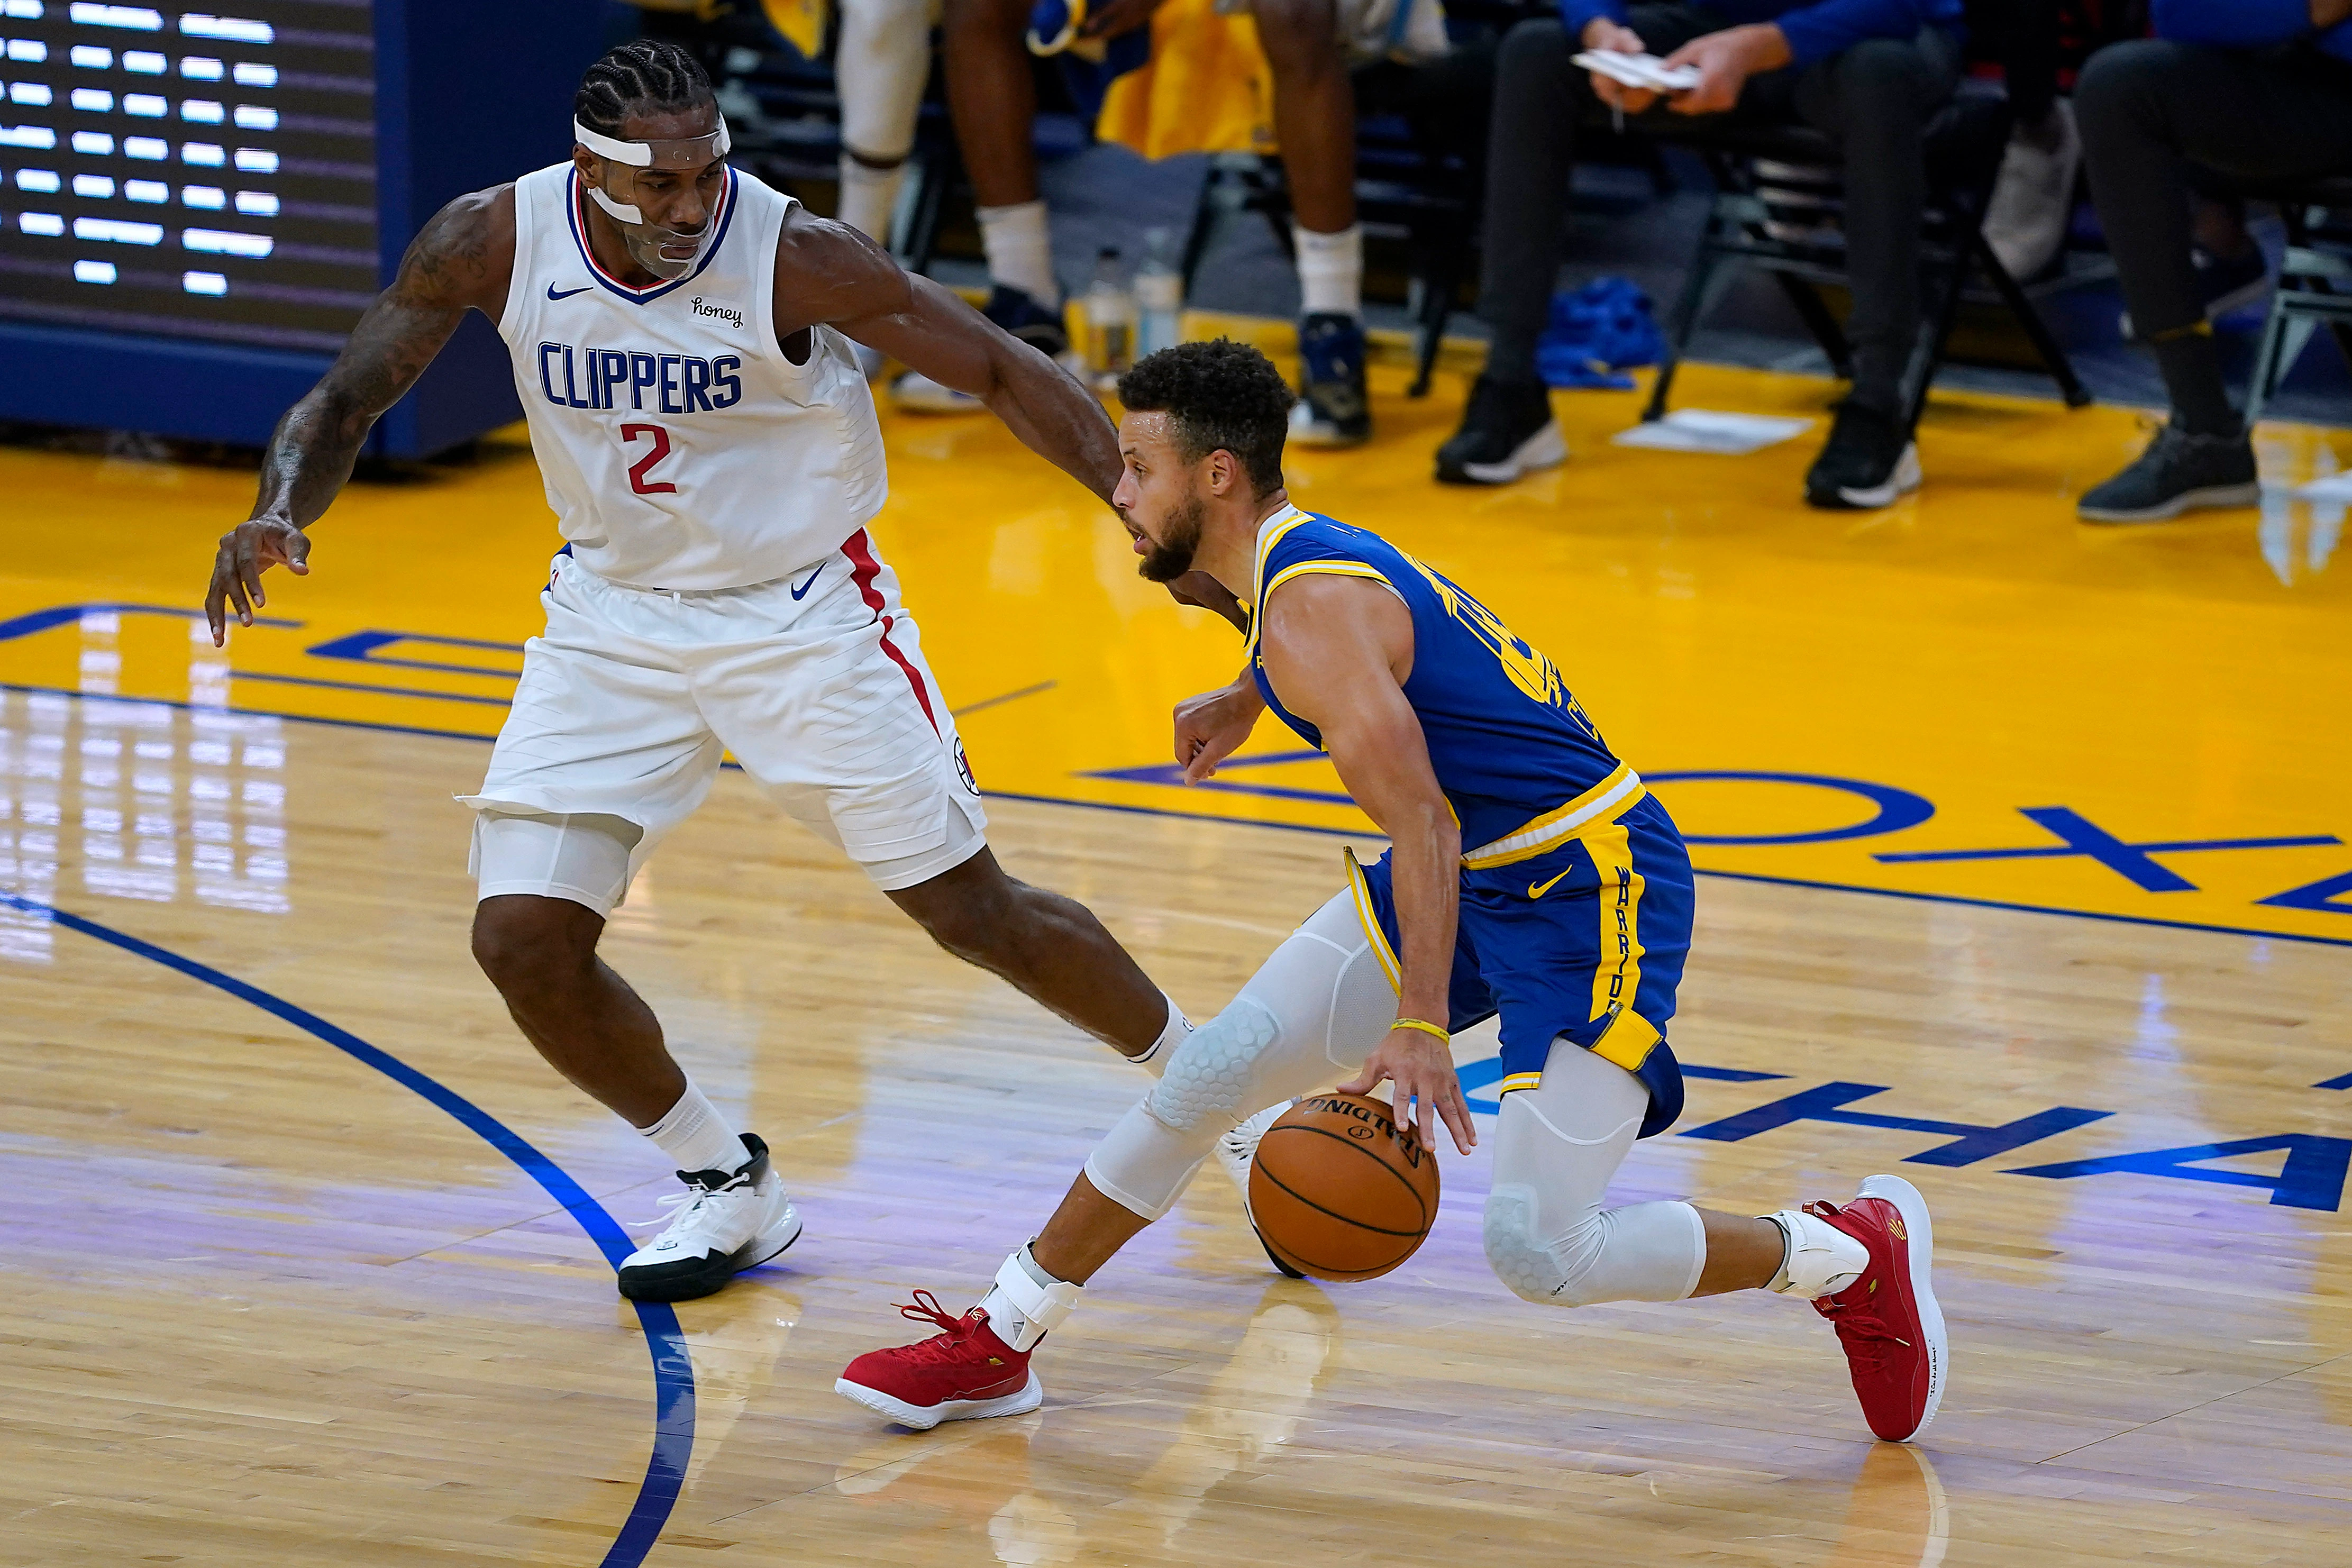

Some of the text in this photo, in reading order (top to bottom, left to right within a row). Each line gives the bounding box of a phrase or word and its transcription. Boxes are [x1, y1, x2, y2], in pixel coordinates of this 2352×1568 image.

[691, 297, 743, 328] honey
[537, 341, 742, 414] CLIPPERS
[620, 423, 677, 495] 2
[1609, 865, 1631, 1009] WARRIO
